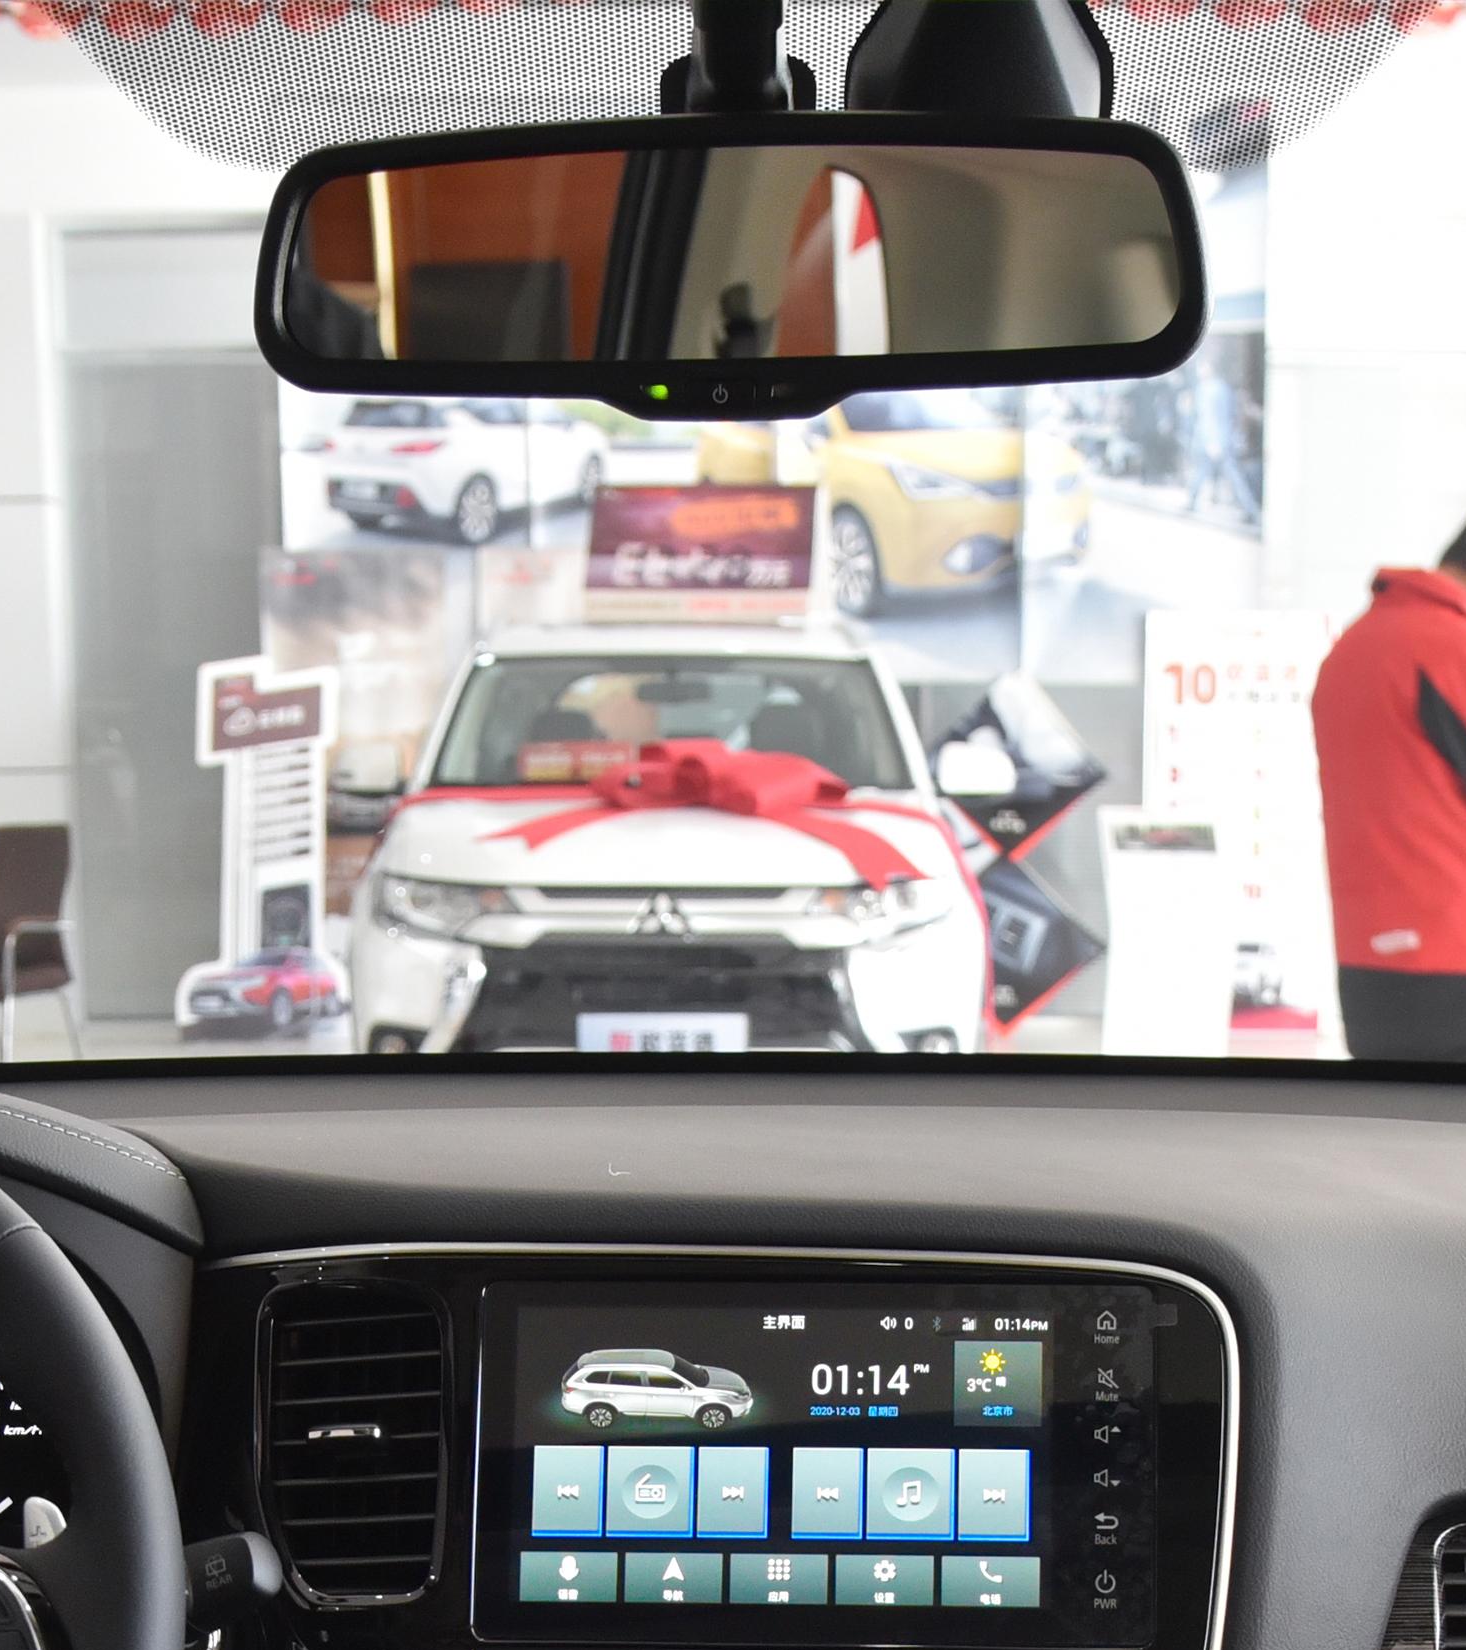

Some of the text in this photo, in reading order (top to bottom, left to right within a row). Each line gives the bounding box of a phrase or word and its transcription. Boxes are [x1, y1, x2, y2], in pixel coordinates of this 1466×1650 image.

[1163, 663, 1217, 704] 10
[763, 1315, 805, 1330] 主界面
[904, 1317, 914, 1330] 0
[1094, 1334, 1120, 1345] Home
[810, 1363, 930, 1396] 01:14 PM
[1095, 1390, 1119, 1402] Mute
[809, 1406, 861, 1417] 2020-12-03
[982, 1405, 1013, 1417] 北京市
[1094, 1533, 1117, 1545] Back
[205, 1573, 233, 1592] REAR
[1094, 1598, 1117, 1609] PWR
